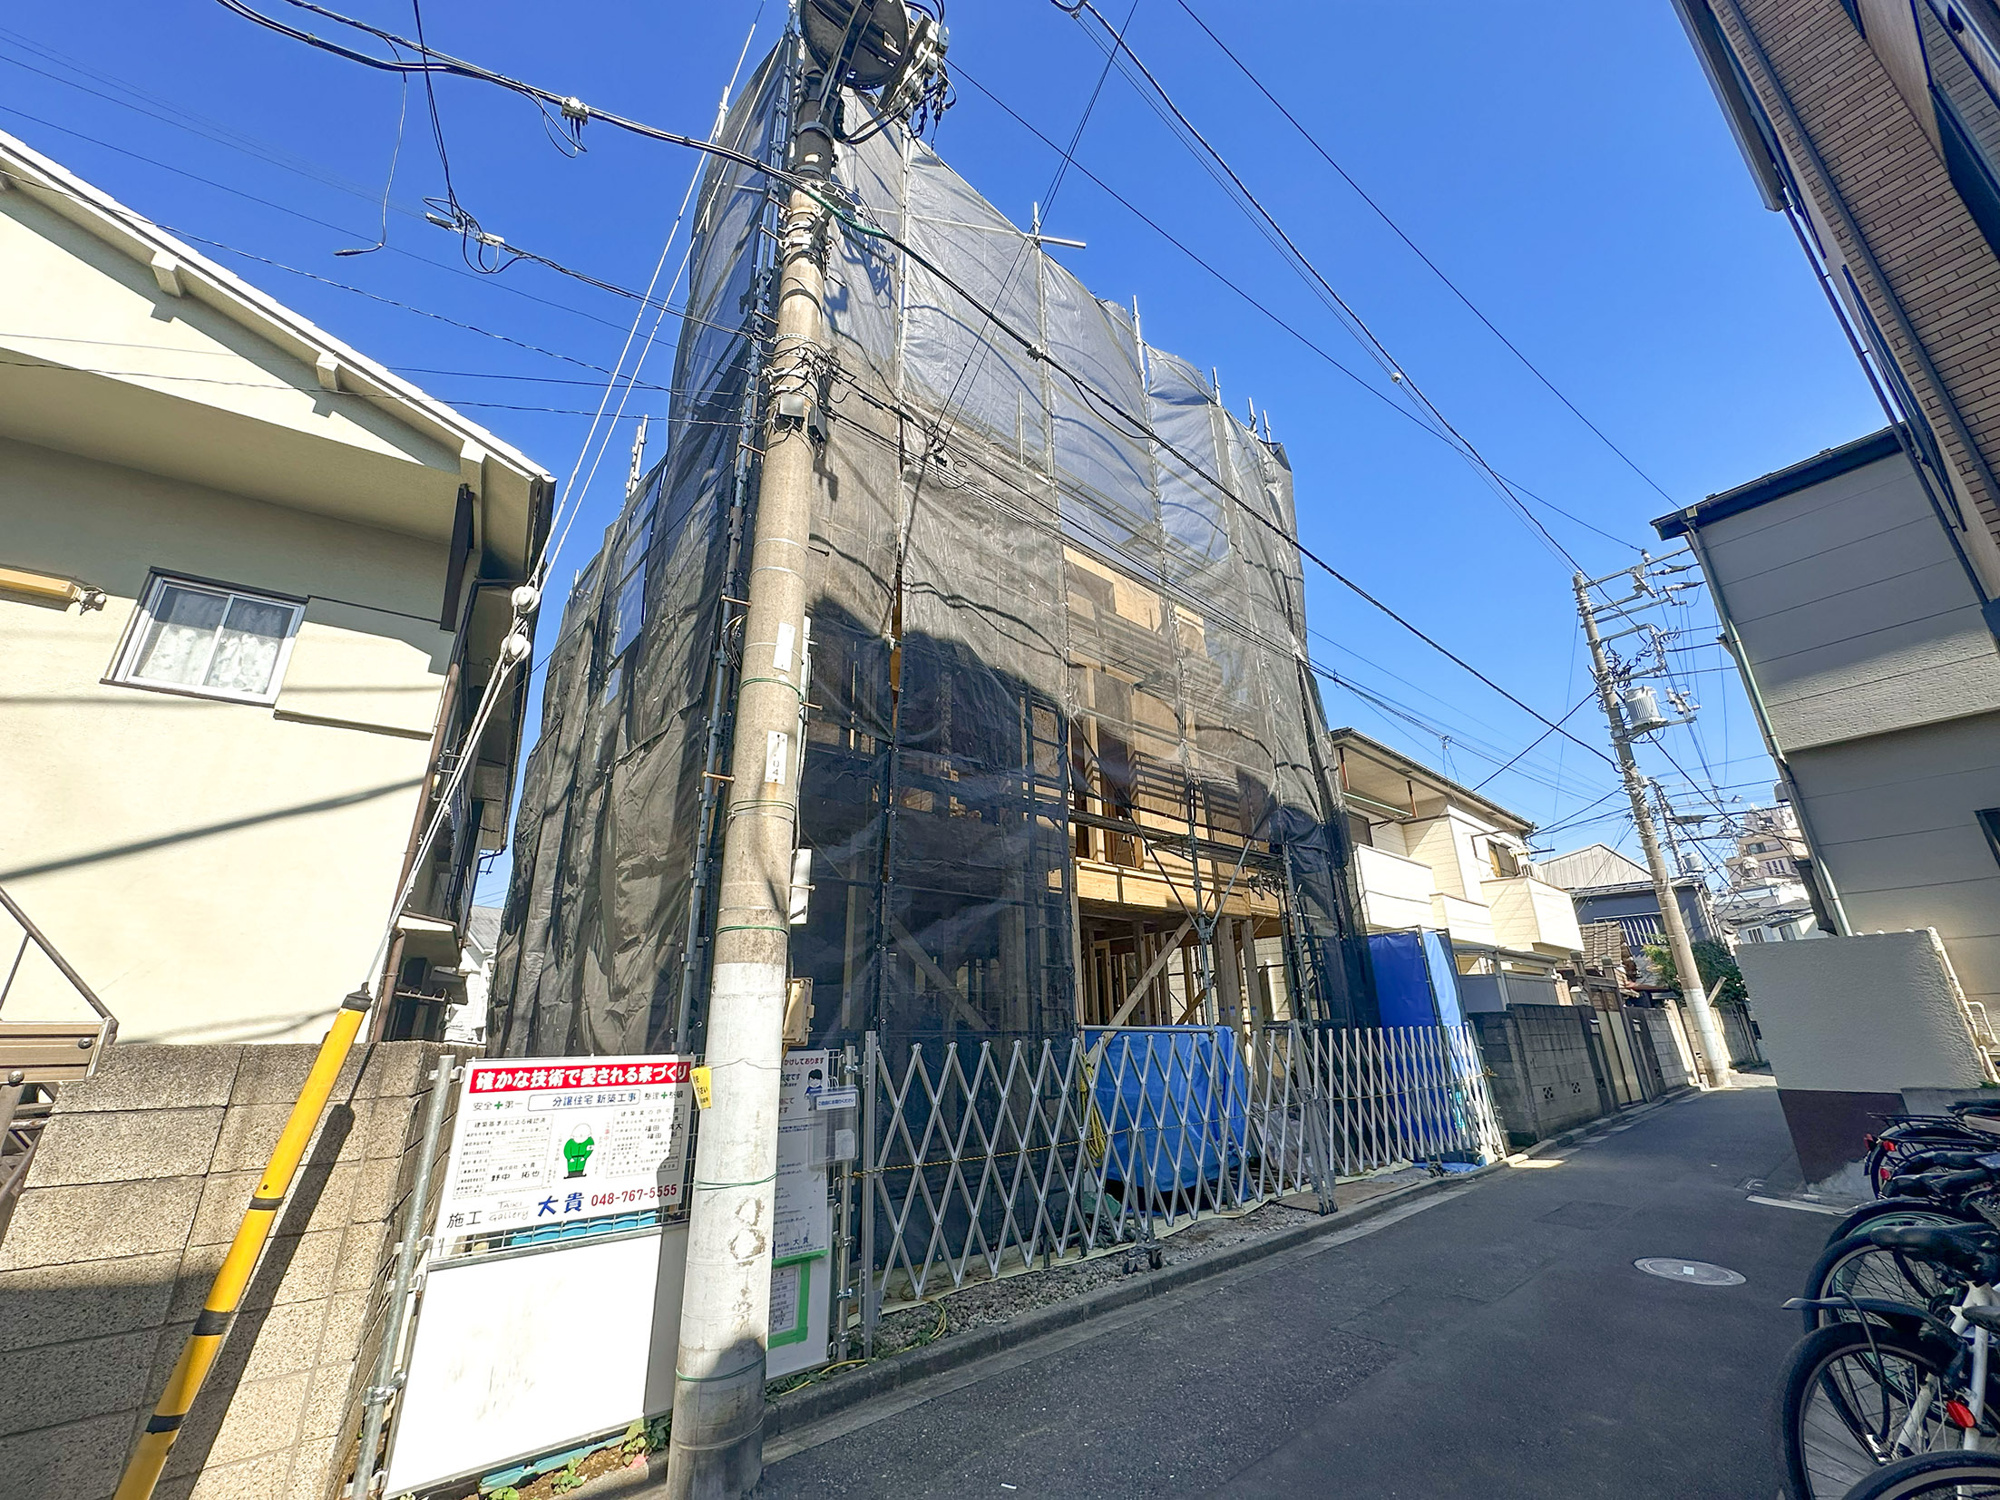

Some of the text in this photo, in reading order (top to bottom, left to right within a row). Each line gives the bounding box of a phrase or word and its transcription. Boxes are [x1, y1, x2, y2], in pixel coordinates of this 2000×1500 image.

[475, 1064, 688, 1090] 確かな技術で愛される家づくり
[552, 1092, 637, 1107] 分譲住宅 新築工事
[446, 1210, 483, 1229] 施工
[537, 1191, 585, 1218] 大貴
[591, 1183, 678, 1207] 048-767-5555
